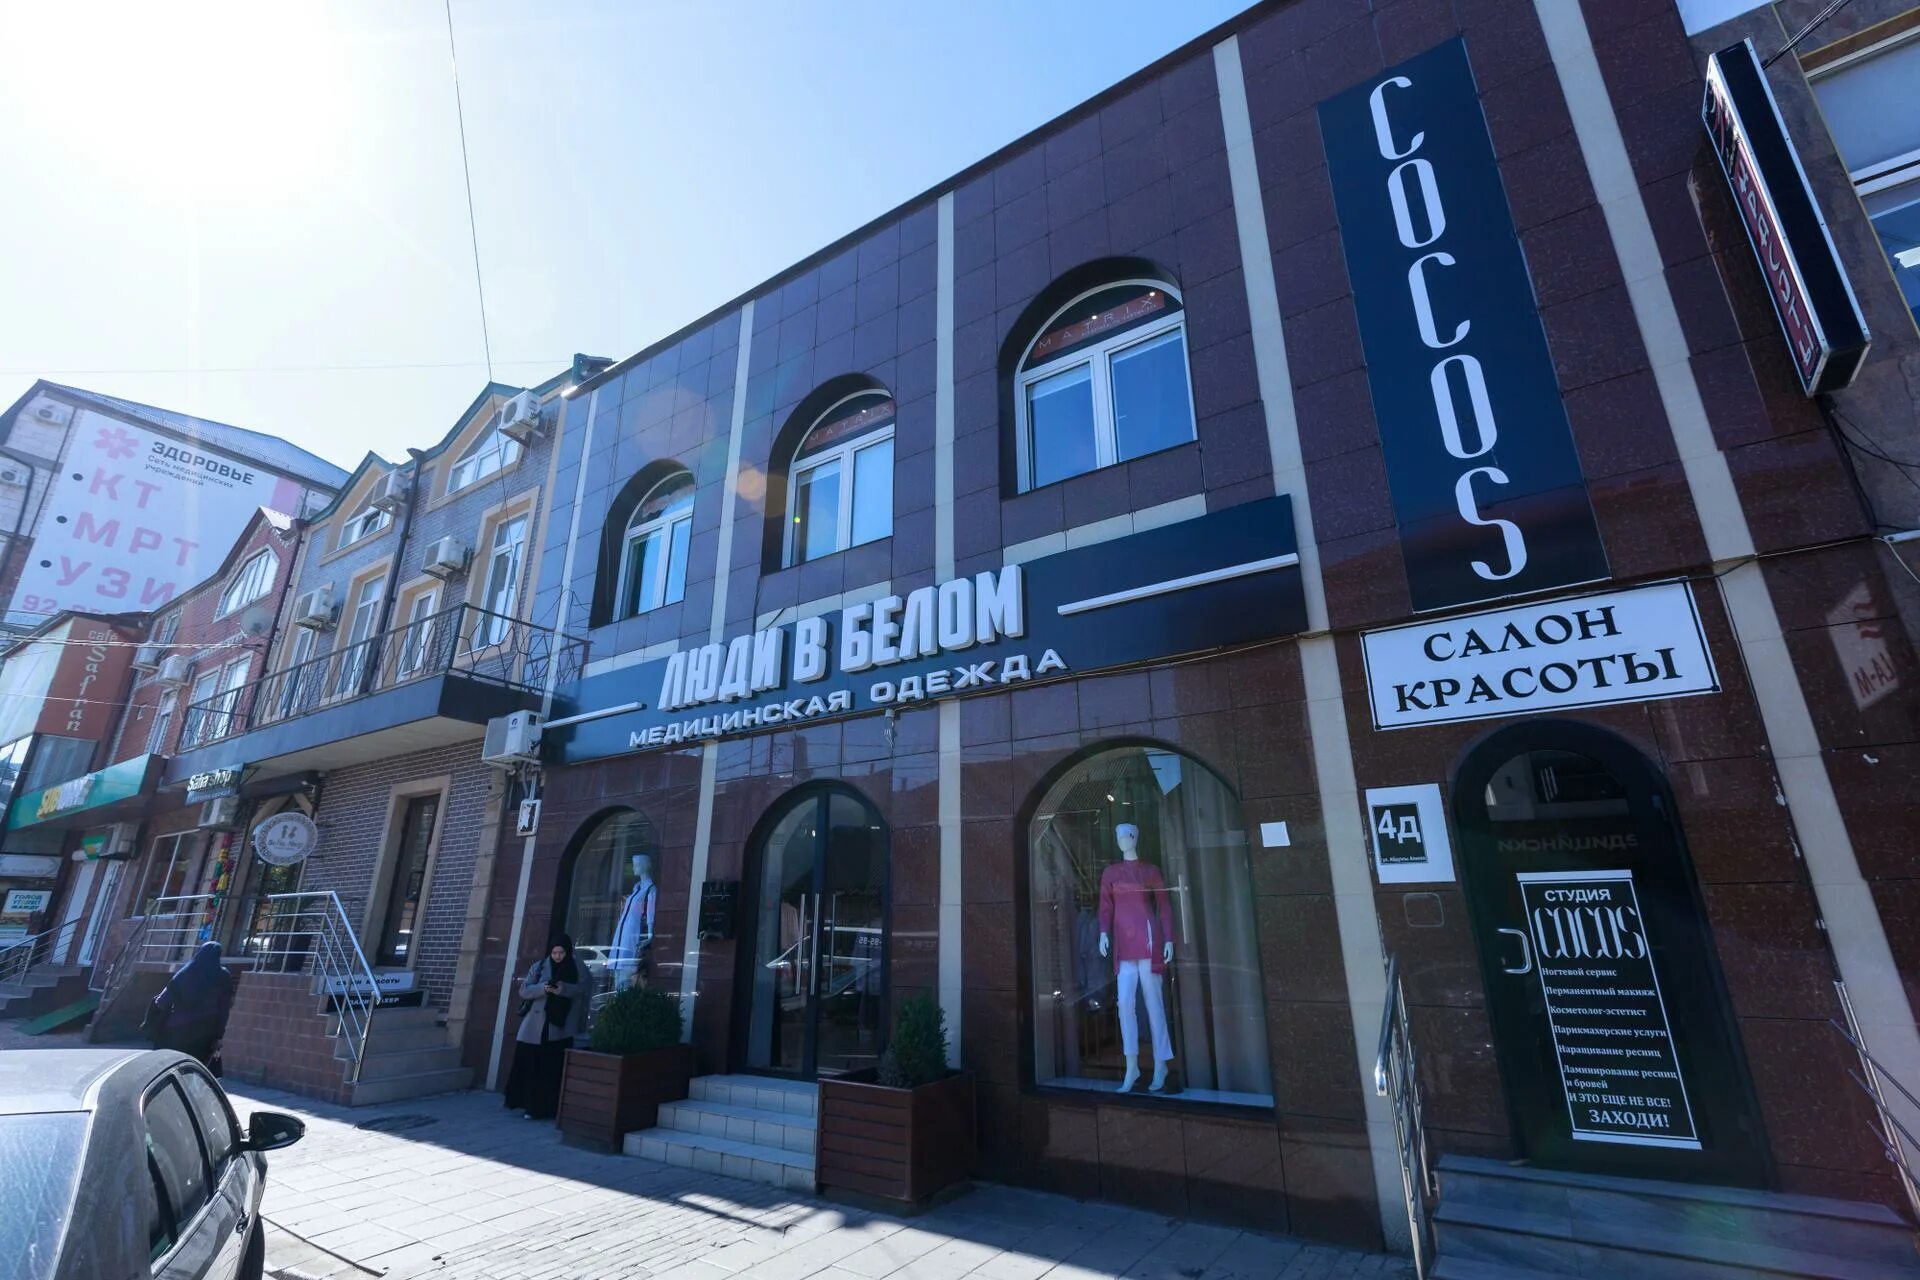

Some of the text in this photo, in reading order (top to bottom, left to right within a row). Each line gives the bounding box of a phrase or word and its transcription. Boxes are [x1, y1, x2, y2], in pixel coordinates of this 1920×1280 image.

[1039, 297, 1152, 349] MATRIX
[1369, 75, 1527, 581] COCOS
[151, 441, 255, 486] ЗДОРОВЬЕ
[88, 466, 163, 510] КТ
[72, 511, 200, 567] МРТ
[56, 555, 177, 606] УЗИ
[658, 564, 1024, 712] ЛЮДИ В БЕЛОМ
[1423, 605, 1623, 662] САЛОН
[629, 648, 1069, 748] МЕДИЦИНСКАЯ ОДЕЖДА
[1394, 647, 1683, 713] КРАСОТЫ
[1377, 809, 1422, 844] 4Д
[1544, 889, 1611, 903] СТУДИЯ
[1534, 906, 1645, 959] COCOS
[1541, 967, 1618, 978] Ногтевой сервис
[1545, 987, 1616, 997] Перманентный
[1550, 1006, 1647, 1016] Косметолог-эстетист
[1553, 1025, 1667, 1038] Парикмахерские услуги
[1558, 1045, 1661, 1058] Наращивание ресниц
[1563, 1064, 1678, 1079] Ламинирование ресниц
[1574, 1079, 1608, 1089] бровей
[1568, 1092, 1672, 1107] И ЭТО ЕЩЕ НЕ ВСЕ!
[1589, 1109, 1669, 1128] ЗАХОДИ!
